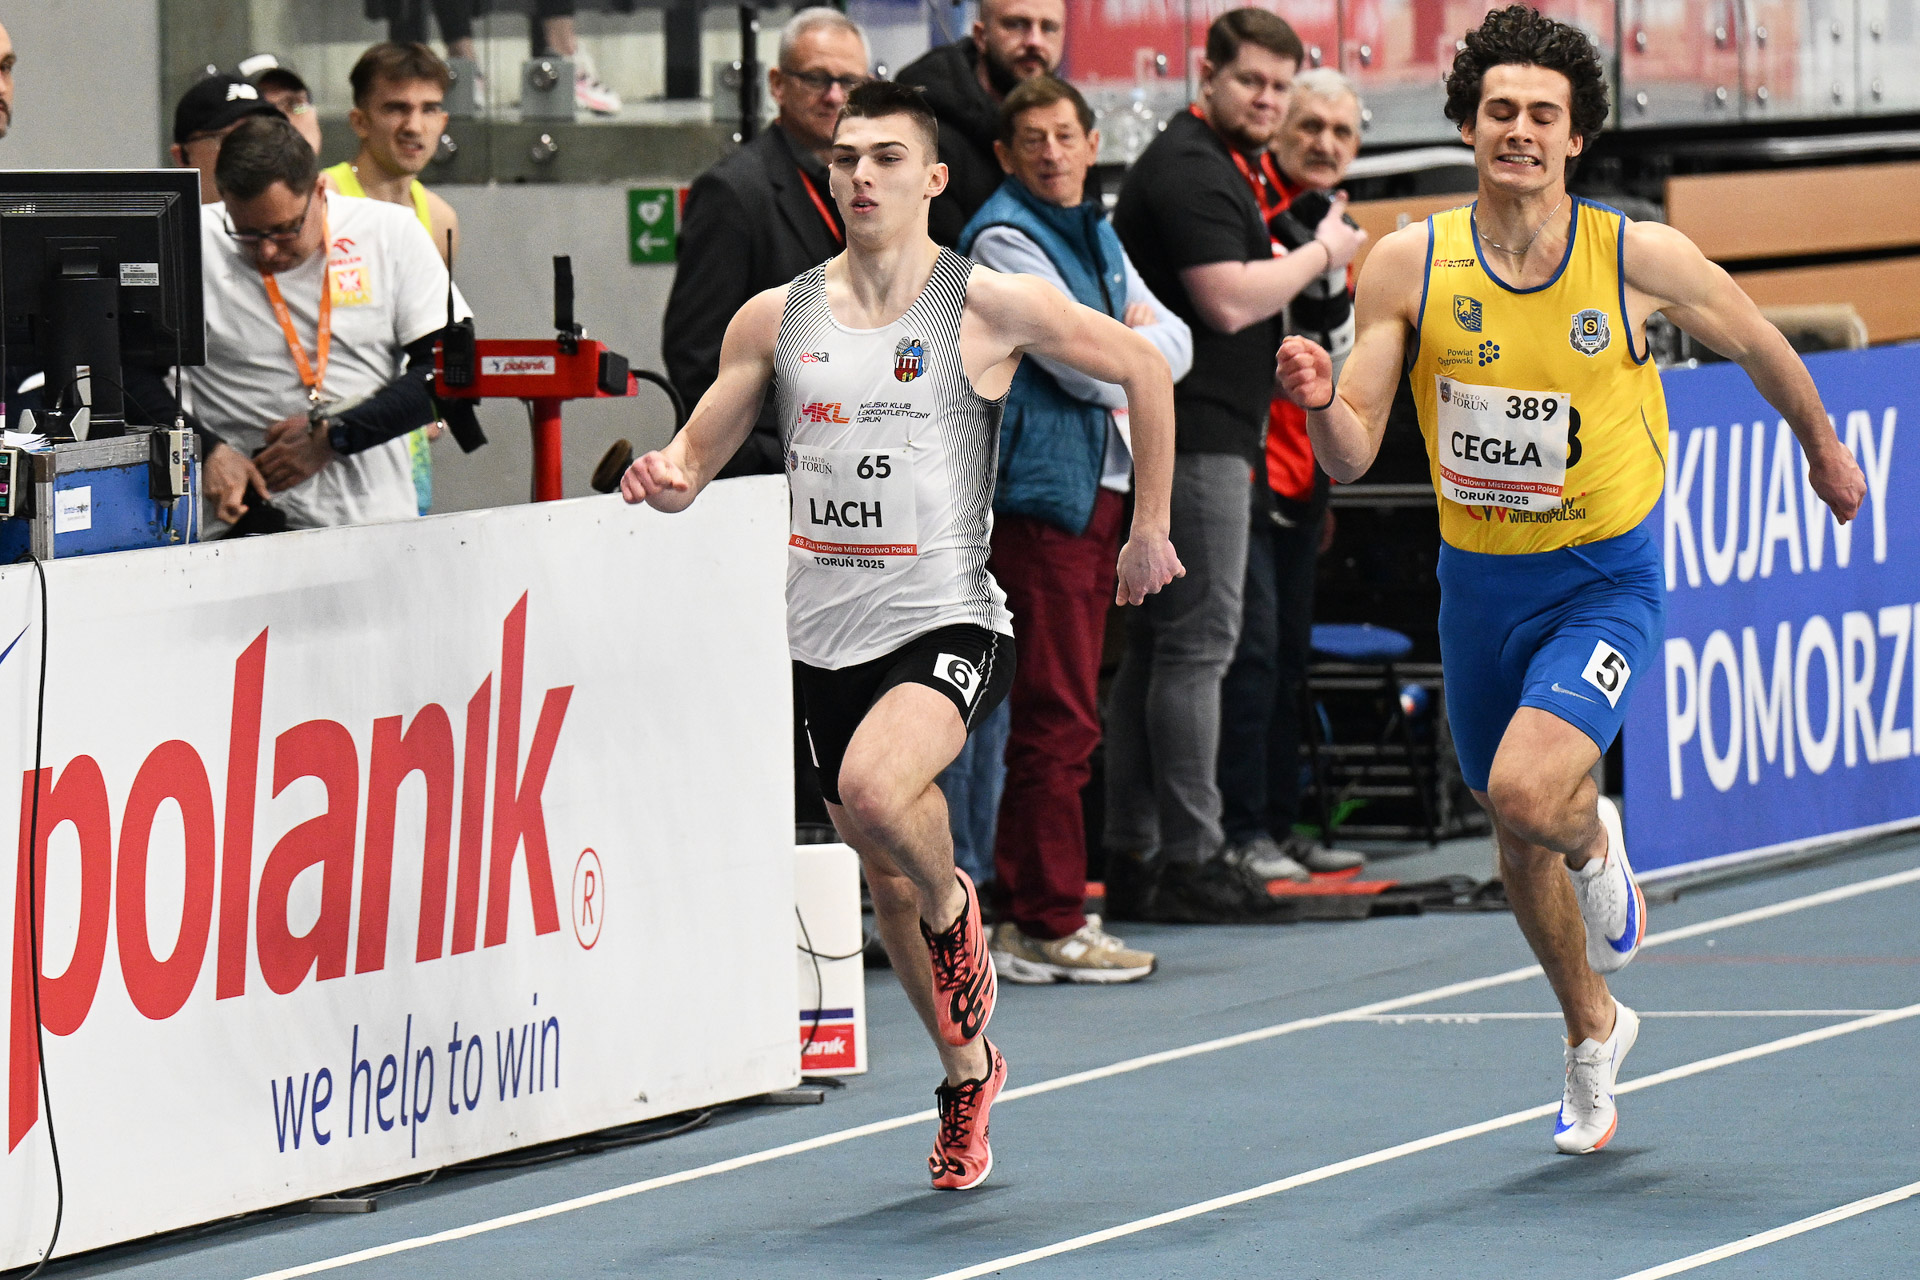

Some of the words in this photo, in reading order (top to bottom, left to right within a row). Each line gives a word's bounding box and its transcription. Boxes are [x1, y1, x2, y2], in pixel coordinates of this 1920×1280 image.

[1438, 357, 1473, 366] Ostrowski
[1447, 349, 1473, 357] Powiat
[1452, 395, 1489, 411] TORUŃ
[1453, 390, 1480, 401] MIASTO
[798, 402, 850, 423] MKL
[857, 409, 931, 419] LEKKOATLETYCZNY
[889, 402, 911, 410] KLUB
[1505, 395, 1558, 421] 389
[1451, 431, 1542, 468] CEGŁA
[800, 461, 832, 474] TORUŃ
[802, 455, 825, 463] MIASTO
[857, 455, 891, 479] 65
[1457, 476, 1486, 487] Halowe
[1488, 481, 1536, 492] Mistrzostwa
[1537, 484, 1559, 494] Polski
[1454, 488, 1495, 502] TORUŃ
[1498, 494, 1529, 505] 2025
[1664, 406, 1898, 592] KUJAWY
[809, 497, 883, 528] LACH
[816, 543, 842, 552] Halowe
[844, 545, 890, 554] Mistrzostwa
[891, 545, 913, 554] Polski
[814, 556, 854, 568] TORUŃ
[856, 558, 885, 569] 2025
[947, 659, 973, 691] 6
[1596, 651, 1625, 692] 5
[1664, 601, 1920, 801] POMORZ
[8, 588, 575, 1155] polanik
[271, 1067, 333, 1153] we
[348, 1013, 434, 1158] help
[447, 1021, 483, 1115] to
[496, 992, 560, 1101] win
